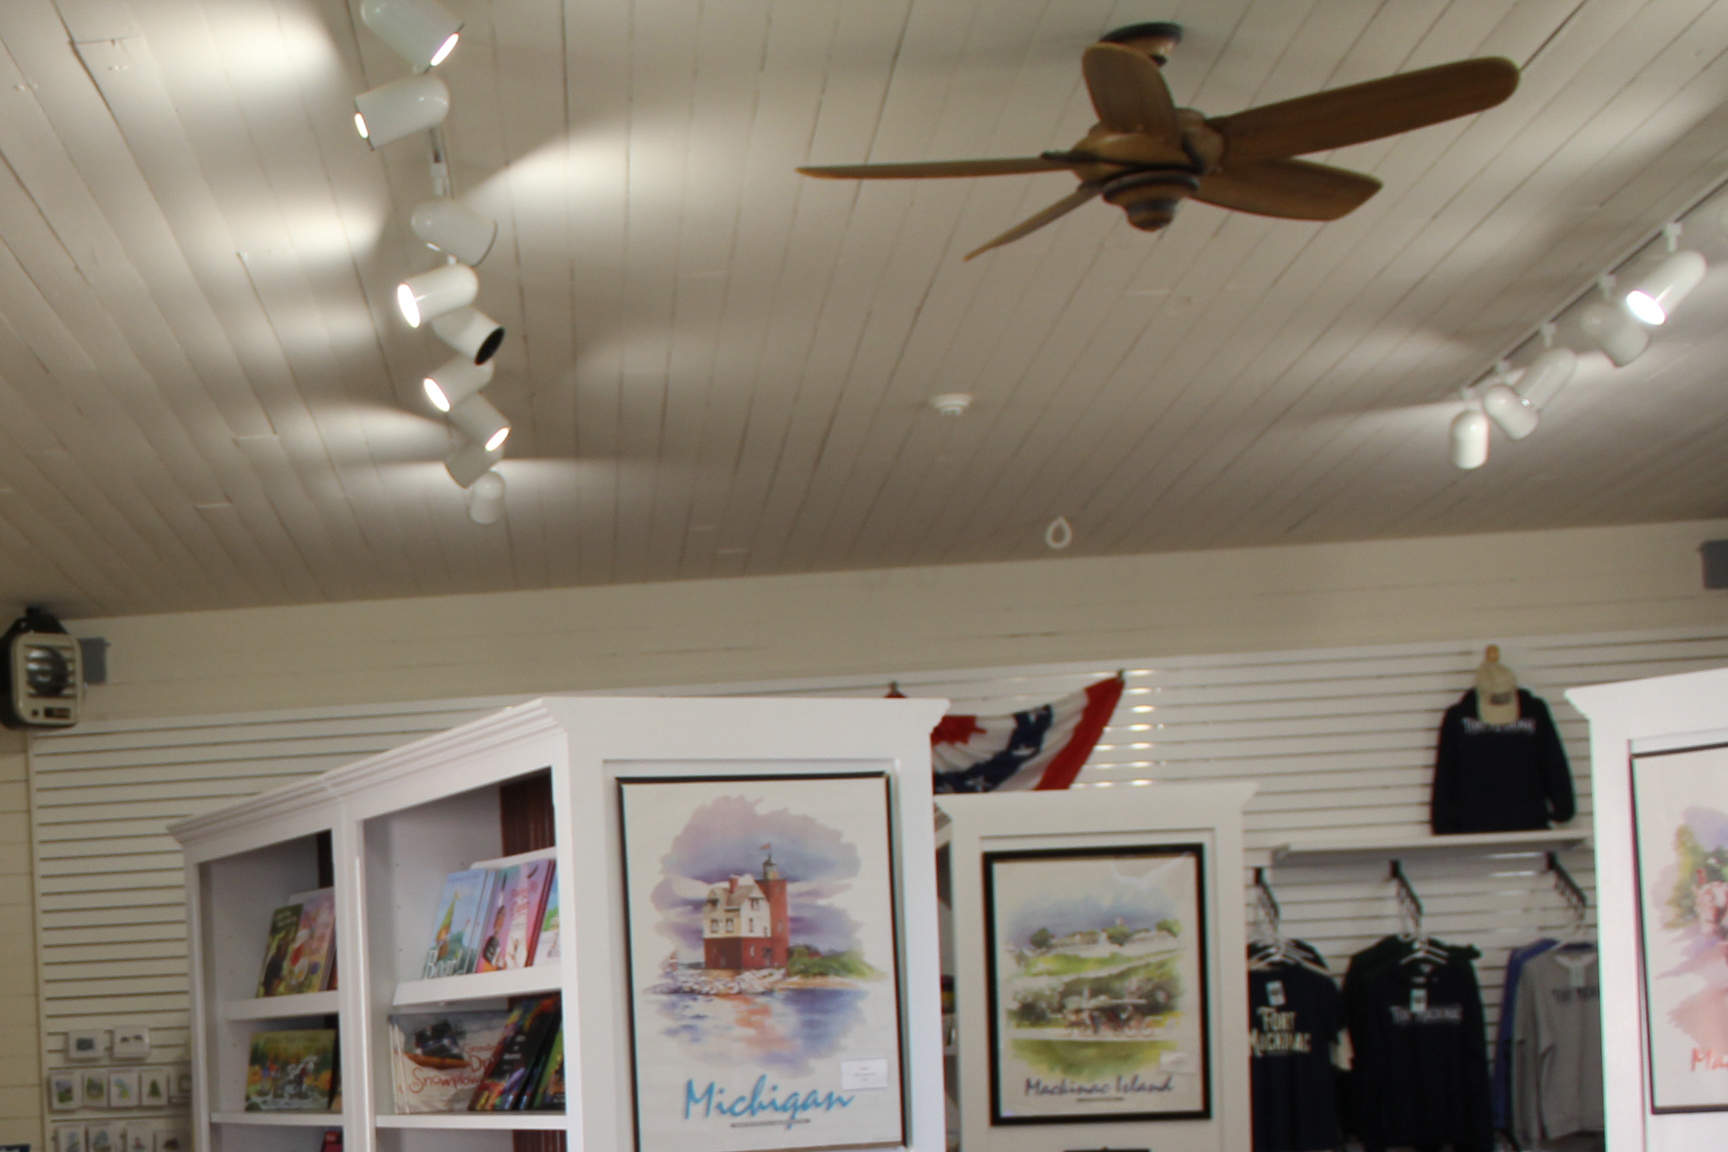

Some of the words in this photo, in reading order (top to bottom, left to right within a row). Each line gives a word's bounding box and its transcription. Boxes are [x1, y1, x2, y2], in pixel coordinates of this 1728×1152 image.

[684, 1073, 855, 1130] Michigan
[1024, 1077, 1110, 1097] Mackinac
[1115, 1073, 1175, 1094] Island
